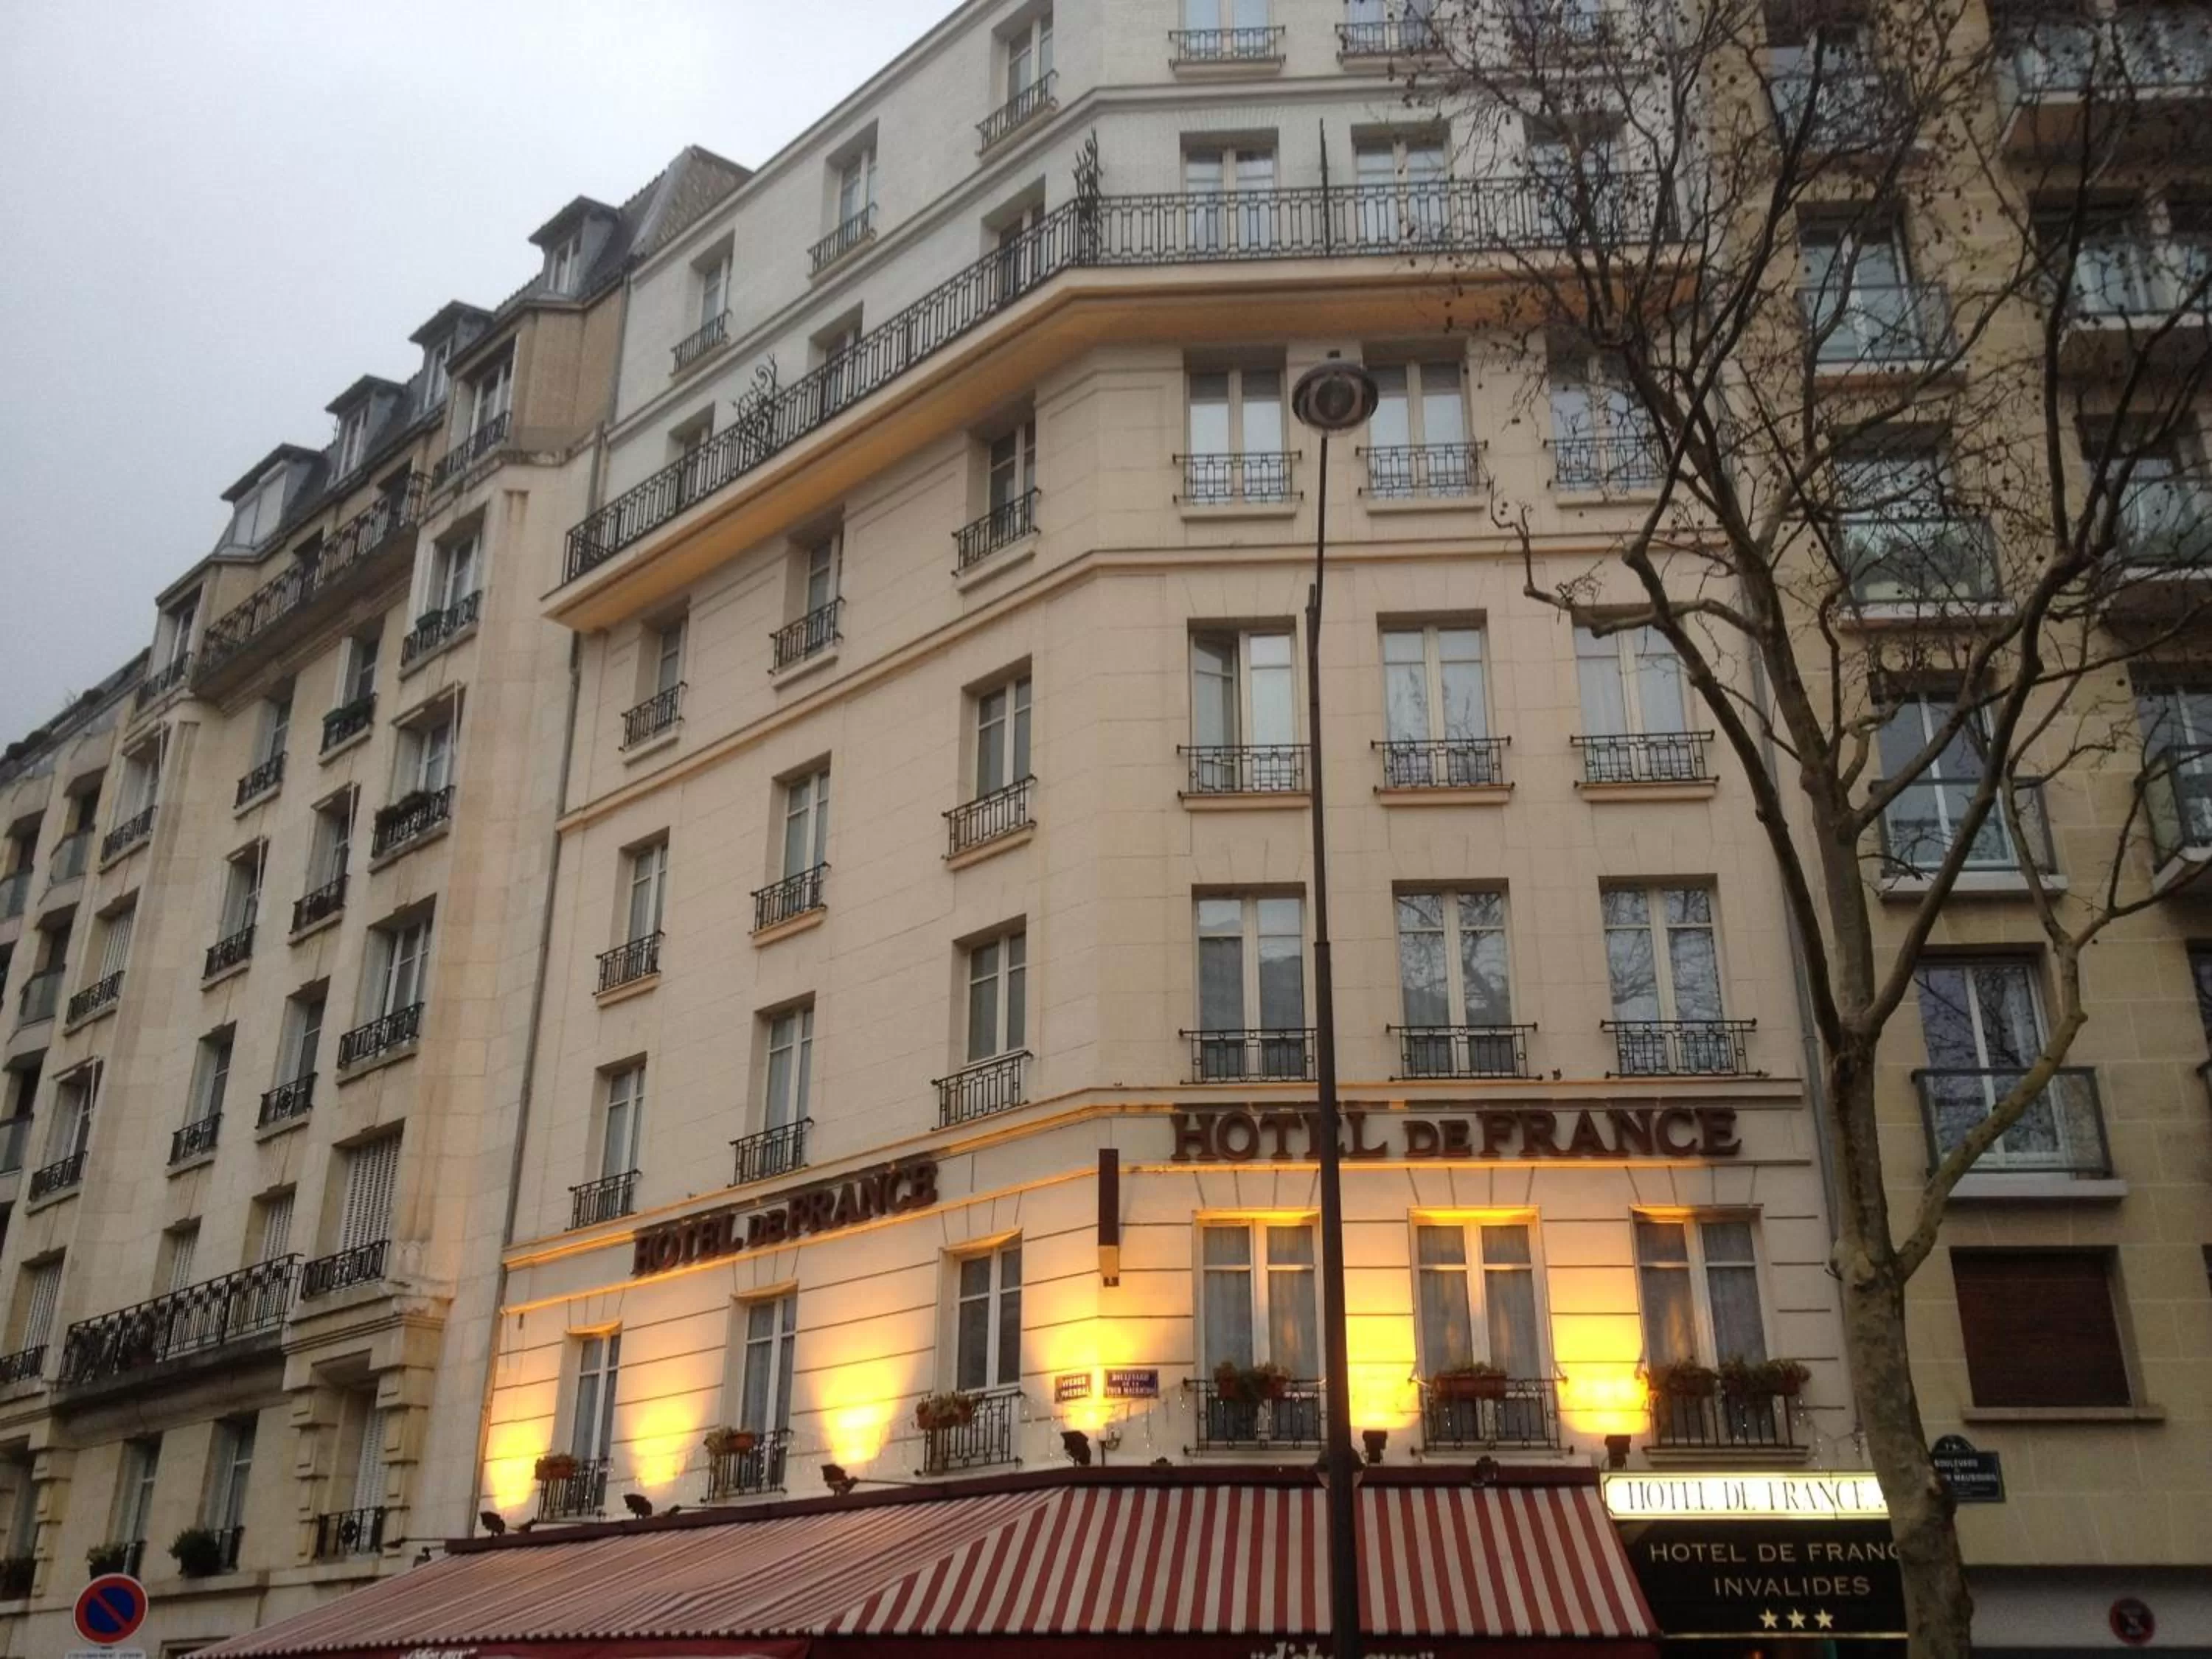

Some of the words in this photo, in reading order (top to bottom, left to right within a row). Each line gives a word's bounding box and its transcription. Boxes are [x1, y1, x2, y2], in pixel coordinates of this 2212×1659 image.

[1404, 1119, 1472, 1158] DE
[1476, 1107, 1742, 1158] FRANCE
[631, 1213, 744, 1276] HOTEL
[745, 1208, 787, 1248] DE
[786, 1160, 939, 1241] FRANCE
[1627, 1480, 1714, 1511] HOTEL
[1723, 1480, 1756, 1511] DE
[1767, 1479, 1870, 1511] FRANCE
[1649, 1543, 1747, 1563] HOTEL
[1758, 1543, 1796, 1563] DE
[1808, 1543, 1900, 1563] FRANC
[1714, 1576, 1871, 1598] INVALIDES
